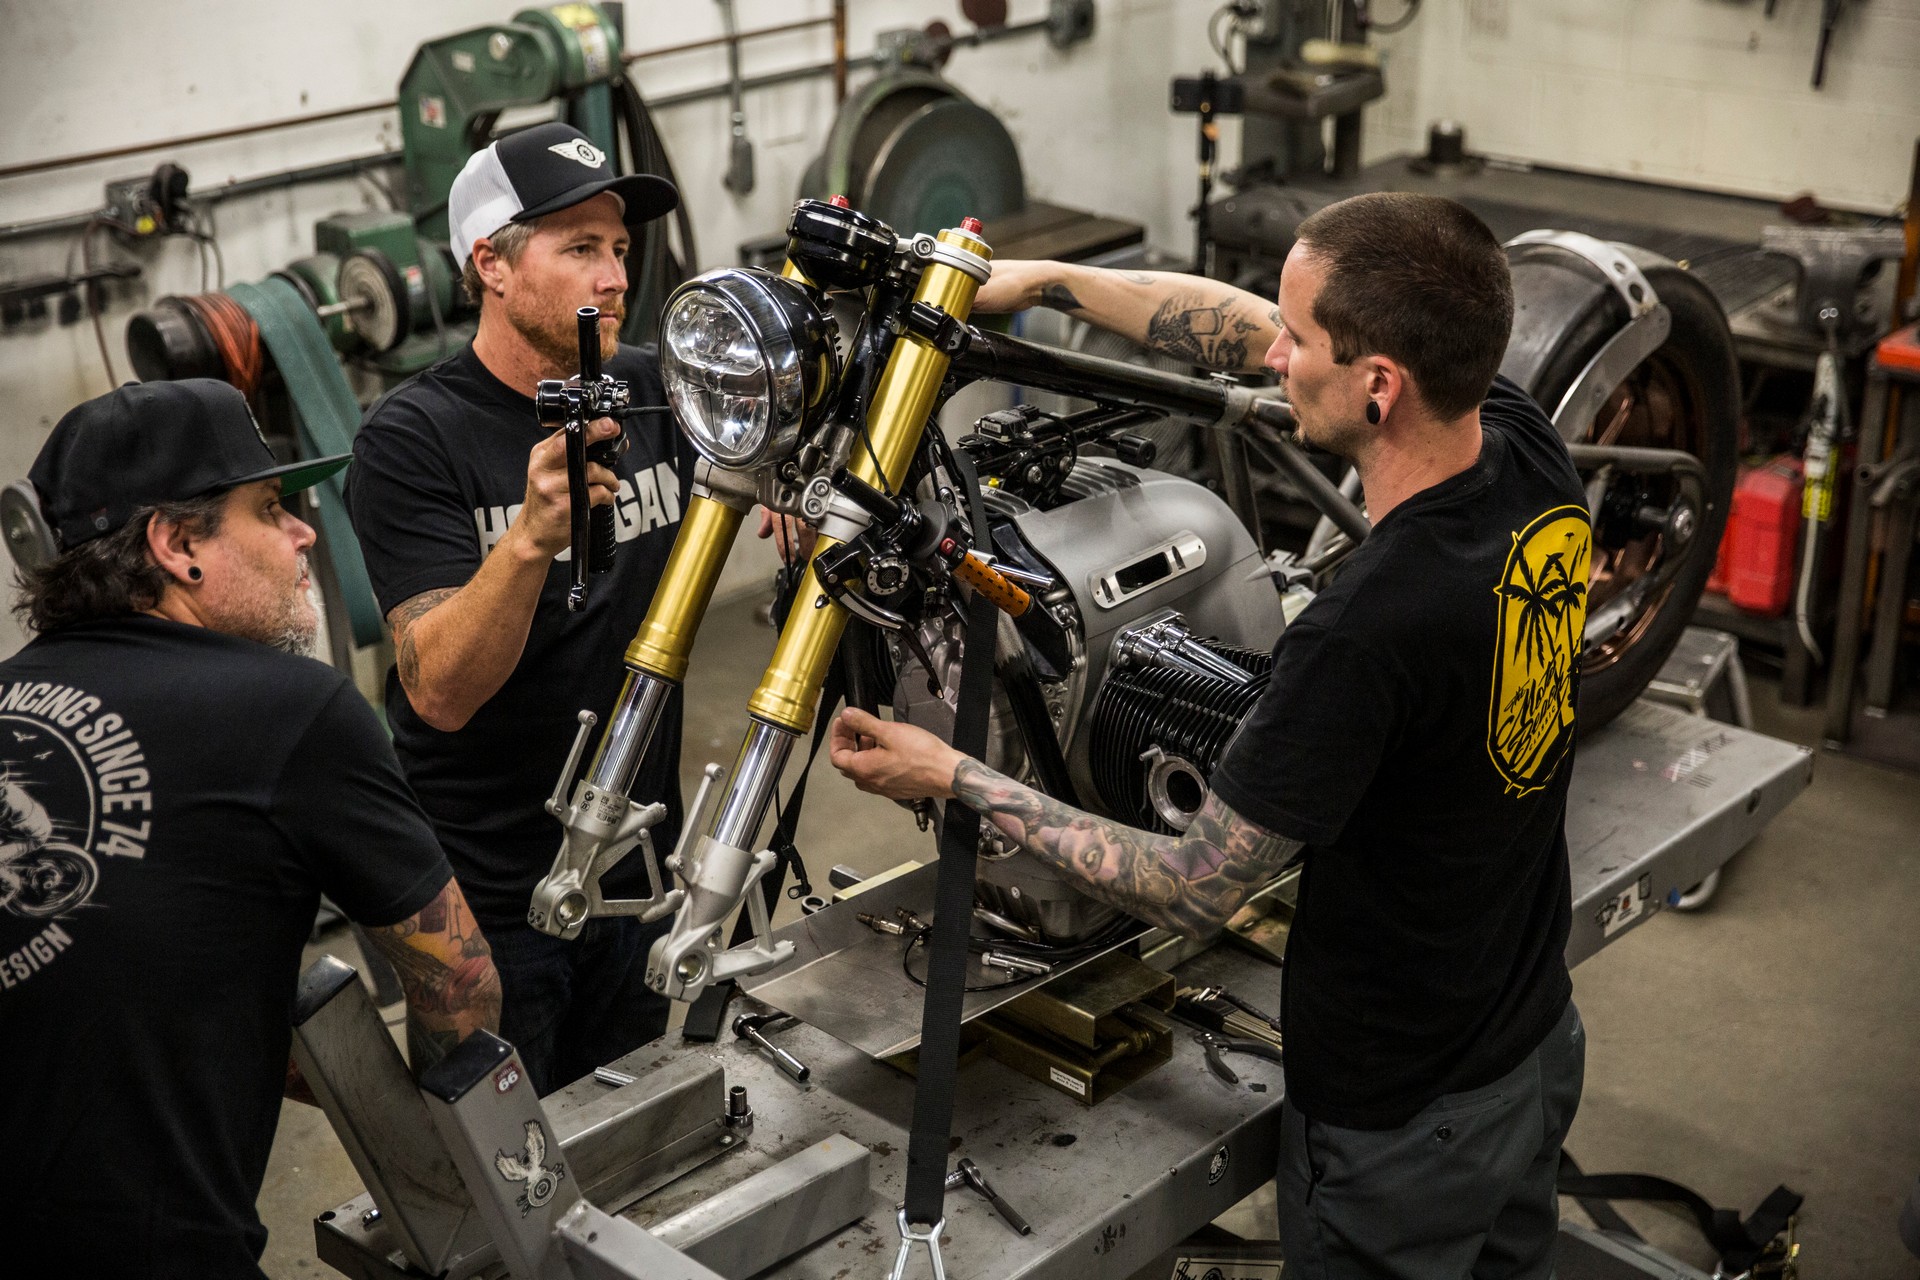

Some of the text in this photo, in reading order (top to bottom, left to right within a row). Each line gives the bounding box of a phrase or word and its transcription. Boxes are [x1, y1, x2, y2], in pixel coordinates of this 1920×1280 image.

[0, 682, 152, 859] NCING SINCE 74
[0, 922, 73, 989] ESIGN
[498, 1070, 518, 1091] 66
